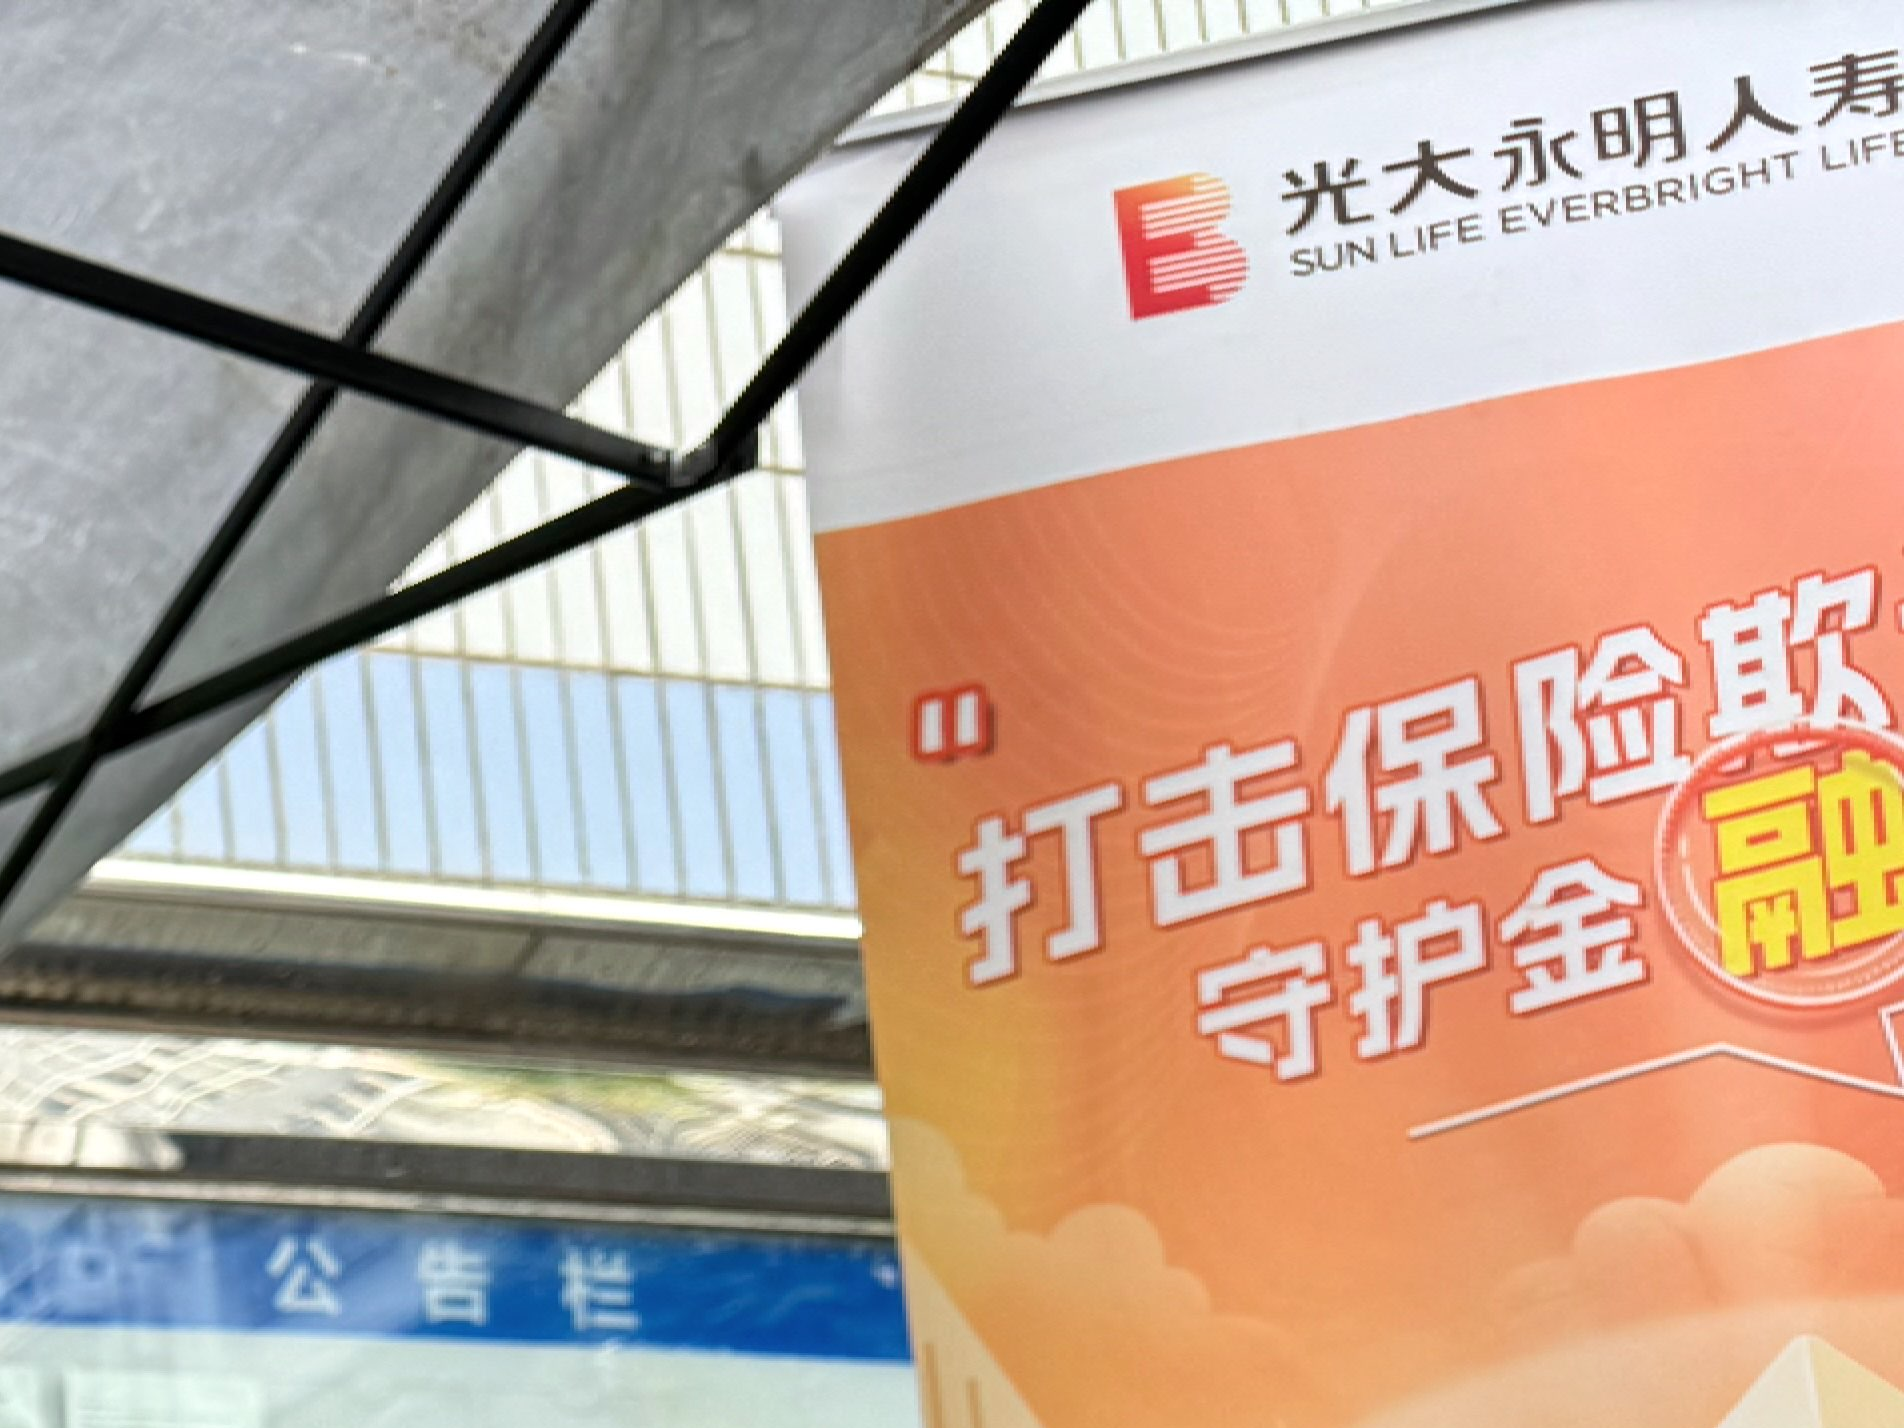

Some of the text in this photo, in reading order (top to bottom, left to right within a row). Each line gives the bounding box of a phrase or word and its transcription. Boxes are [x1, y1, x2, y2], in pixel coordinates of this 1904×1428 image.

[1281, 46, 1904, 237] 光大永明人寿
[1289, 129, 1904, 278] SUN LIFE EVERBRIGHT LIFE
[955, 566, 1904, 988] 打击保险欺
[265, 1234, 641, 1332] 公告栏
